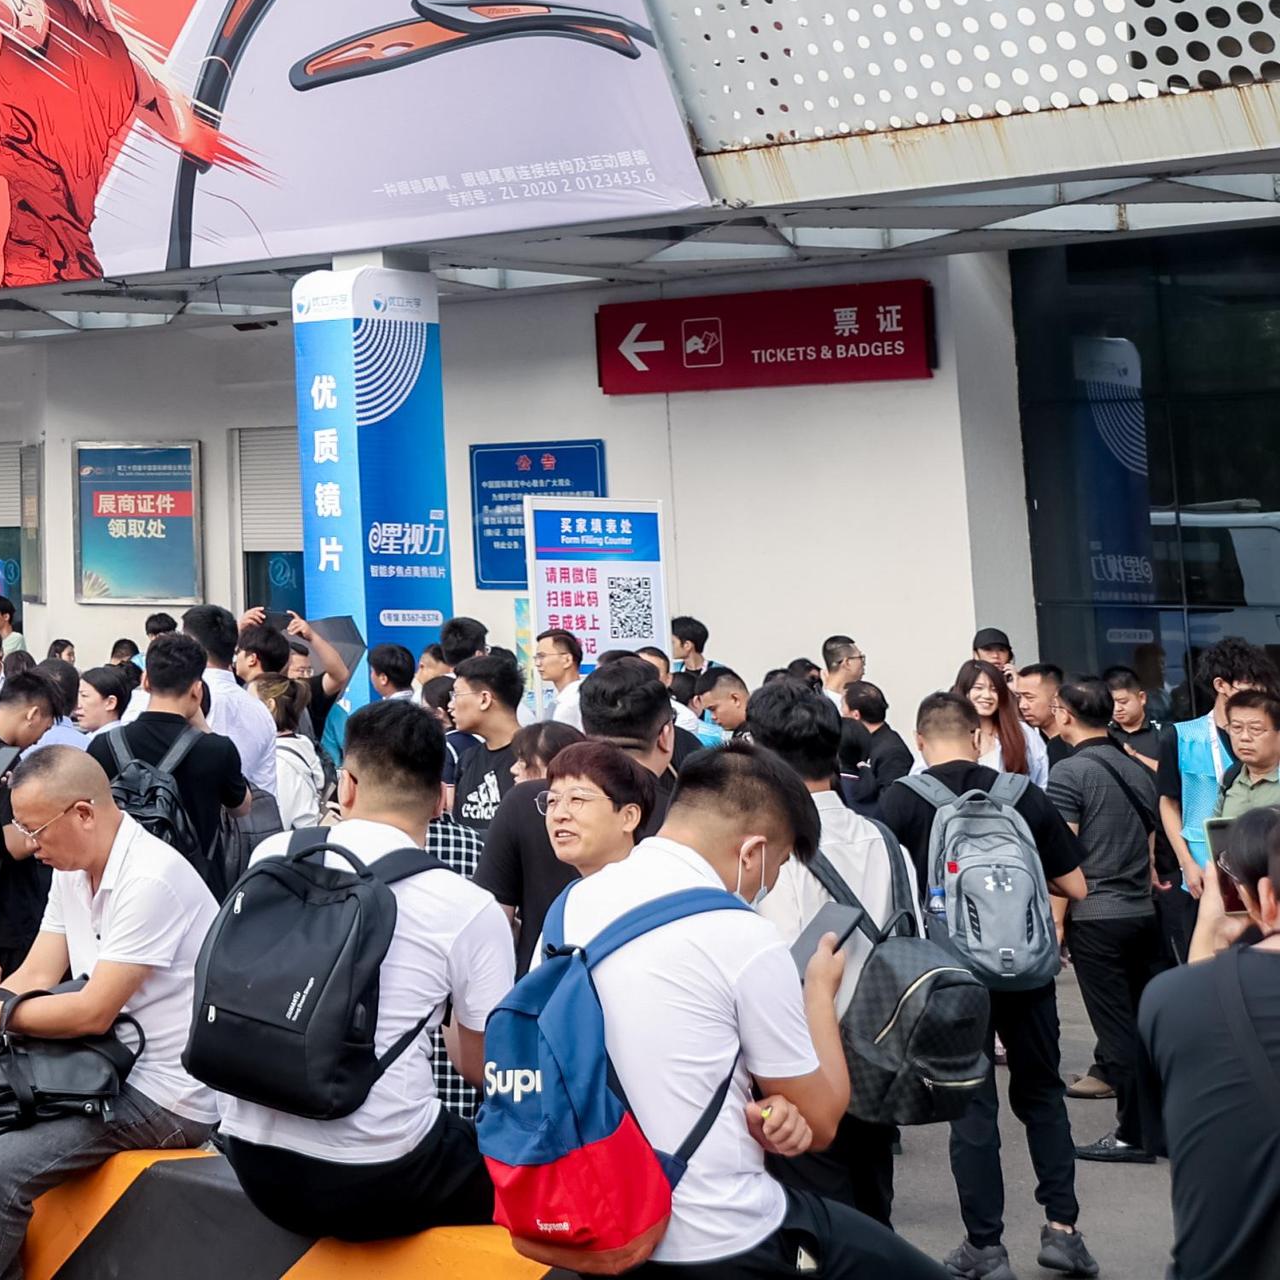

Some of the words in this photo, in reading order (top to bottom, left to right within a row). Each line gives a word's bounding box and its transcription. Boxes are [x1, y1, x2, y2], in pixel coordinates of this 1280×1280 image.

[501, 187, 518, 200] ZL
[523, 180, 557, 197] 2020
[561, 178, 572, 193] 2
[833, 305, 904, 337] 票证
[751, 346, 817, 364] TICKETS
[820, 346, 833, 359] &
[835, 340, 905, 359] BADGES
[310, 375, 344, 572] 优质镜片
[97, 493, 175, 514] 展商证件
[107, 518, 166, 539] 领取处
[560, 517, 633, 534] 买家填表处
[561, 536, 580, 544] Form
[581, 536, 603, 546] Filling
[604, 536, 632, 545] Counter
[545, 567, 598, 584] 请用微信
[546, 591, 599, 608] 扫描此码
[547, 615, 600, 631] 完成线上
